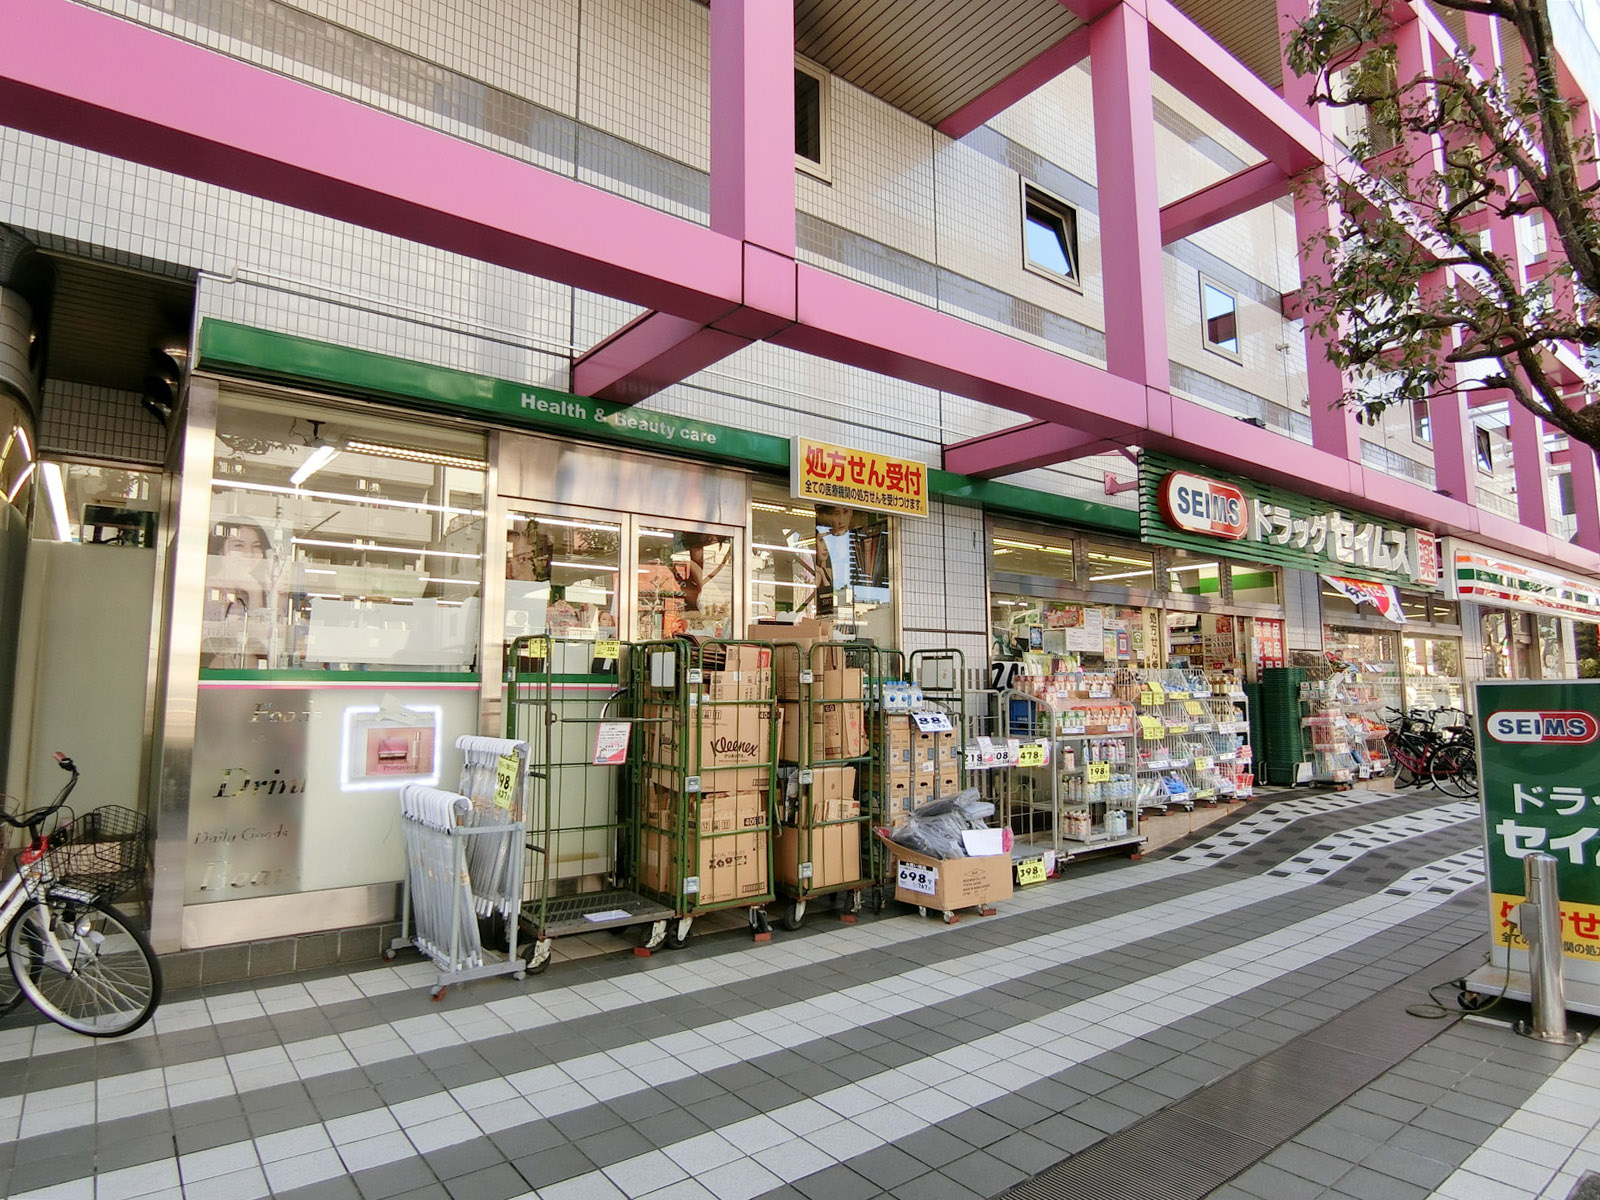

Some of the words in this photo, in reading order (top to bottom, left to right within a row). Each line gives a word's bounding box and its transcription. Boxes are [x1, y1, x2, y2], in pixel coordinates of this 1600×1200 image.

[521, 393, 586, 419] Health
[593, 408, 605, 422] &
[614, 412, 676, 439] Beauty
[680, 428, 717, 444] care
[805, 445, 922, 496] 処方せん受付
[805, 479, 923, 511] 全ての医療機関の処方せんを受けつけます。
[1177, 486, 1241, 527] SEIMS
[1250, 498, 1411, 574] ドラッグセイムス
[918, 716, 942, 725] 88
[1498, 718, 1587, 737] SEIMS
[710, 736, 758, 757] Kleenex
[994, 752, 1008, 760] 08
[1020, 751, 1039, 759] 478
[1090, 767, 1105, 775] 198
[1495, 819, 1600, 867] セイ
[900, 870, 926, 883] 698
[1020, 866, 1039, 877] 398
